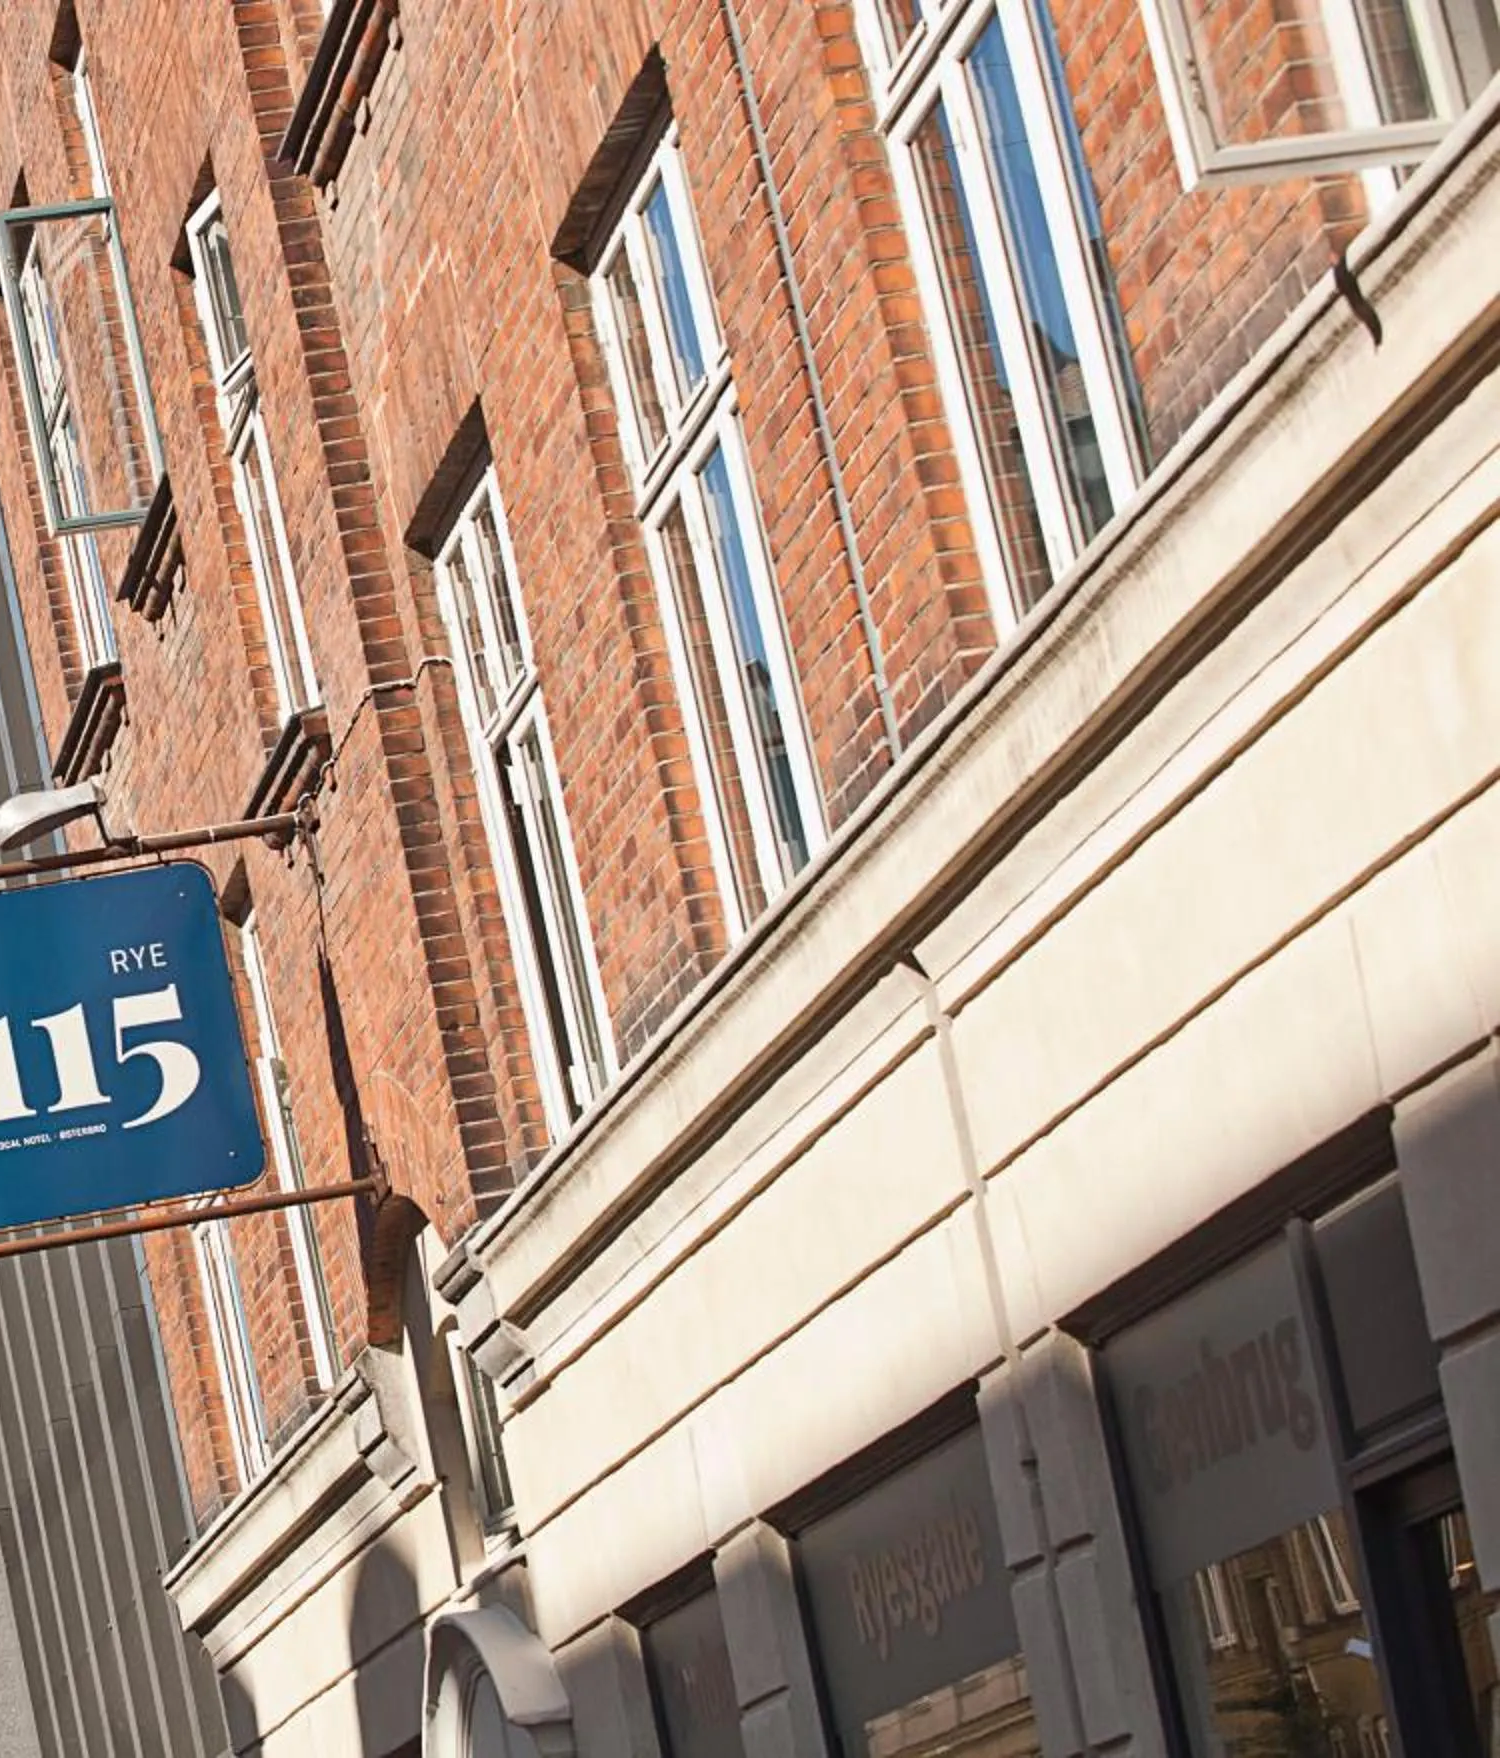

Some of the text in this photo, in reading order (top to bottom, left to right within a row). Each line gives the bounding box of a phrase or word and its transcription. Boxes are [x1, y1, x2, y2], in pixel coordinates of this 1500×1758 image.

[110, 942, 167, 974] RYE
[23, 1133, 52, 1145] HOTEL
[847, 1492, 985, 1662] Ryesgade
